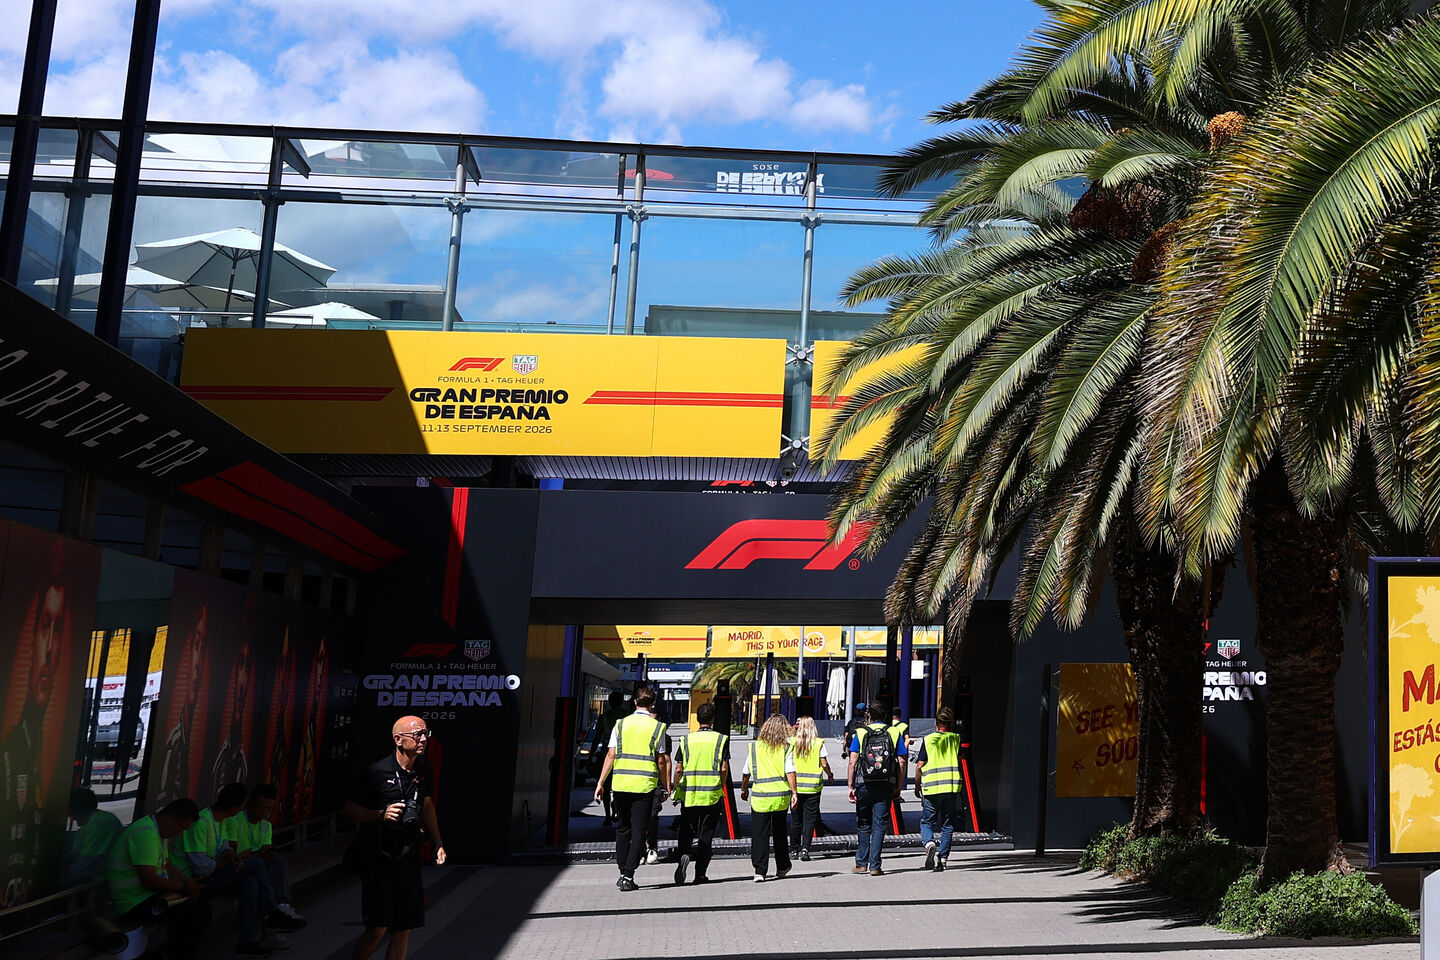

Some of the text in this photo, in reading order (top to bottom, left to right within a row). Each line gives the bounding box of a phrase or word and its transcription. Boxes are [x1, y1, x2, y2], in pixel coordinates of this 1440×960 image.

[437, 376, 481, 384] FORMULA
[409, 387, 569, 405] GRAN PREMIO
[425, 404, 551, 421] DE ESPAÑA
[0, 369, 209, 477] DRIVE FOR
[422, 424, 552, 434] 11-13 SEPTEMBER 2026
[746, 638, 823, 651] THIS IS YOUR RACE
[363, 674, 521, 690] GRAN PREMIO
[1203, 671, 1267, 686] REMIO
[377, 690, 502, 707] DE ESPAÑA
[1203, 685, 1255, 701] PAÑA
[422, 711, 456, 720] 2026
[1202, 705, 1215, 714] 26
[1076, 704, 1115, 734] SEE
[1095, 736, 1138, 767] SOO
